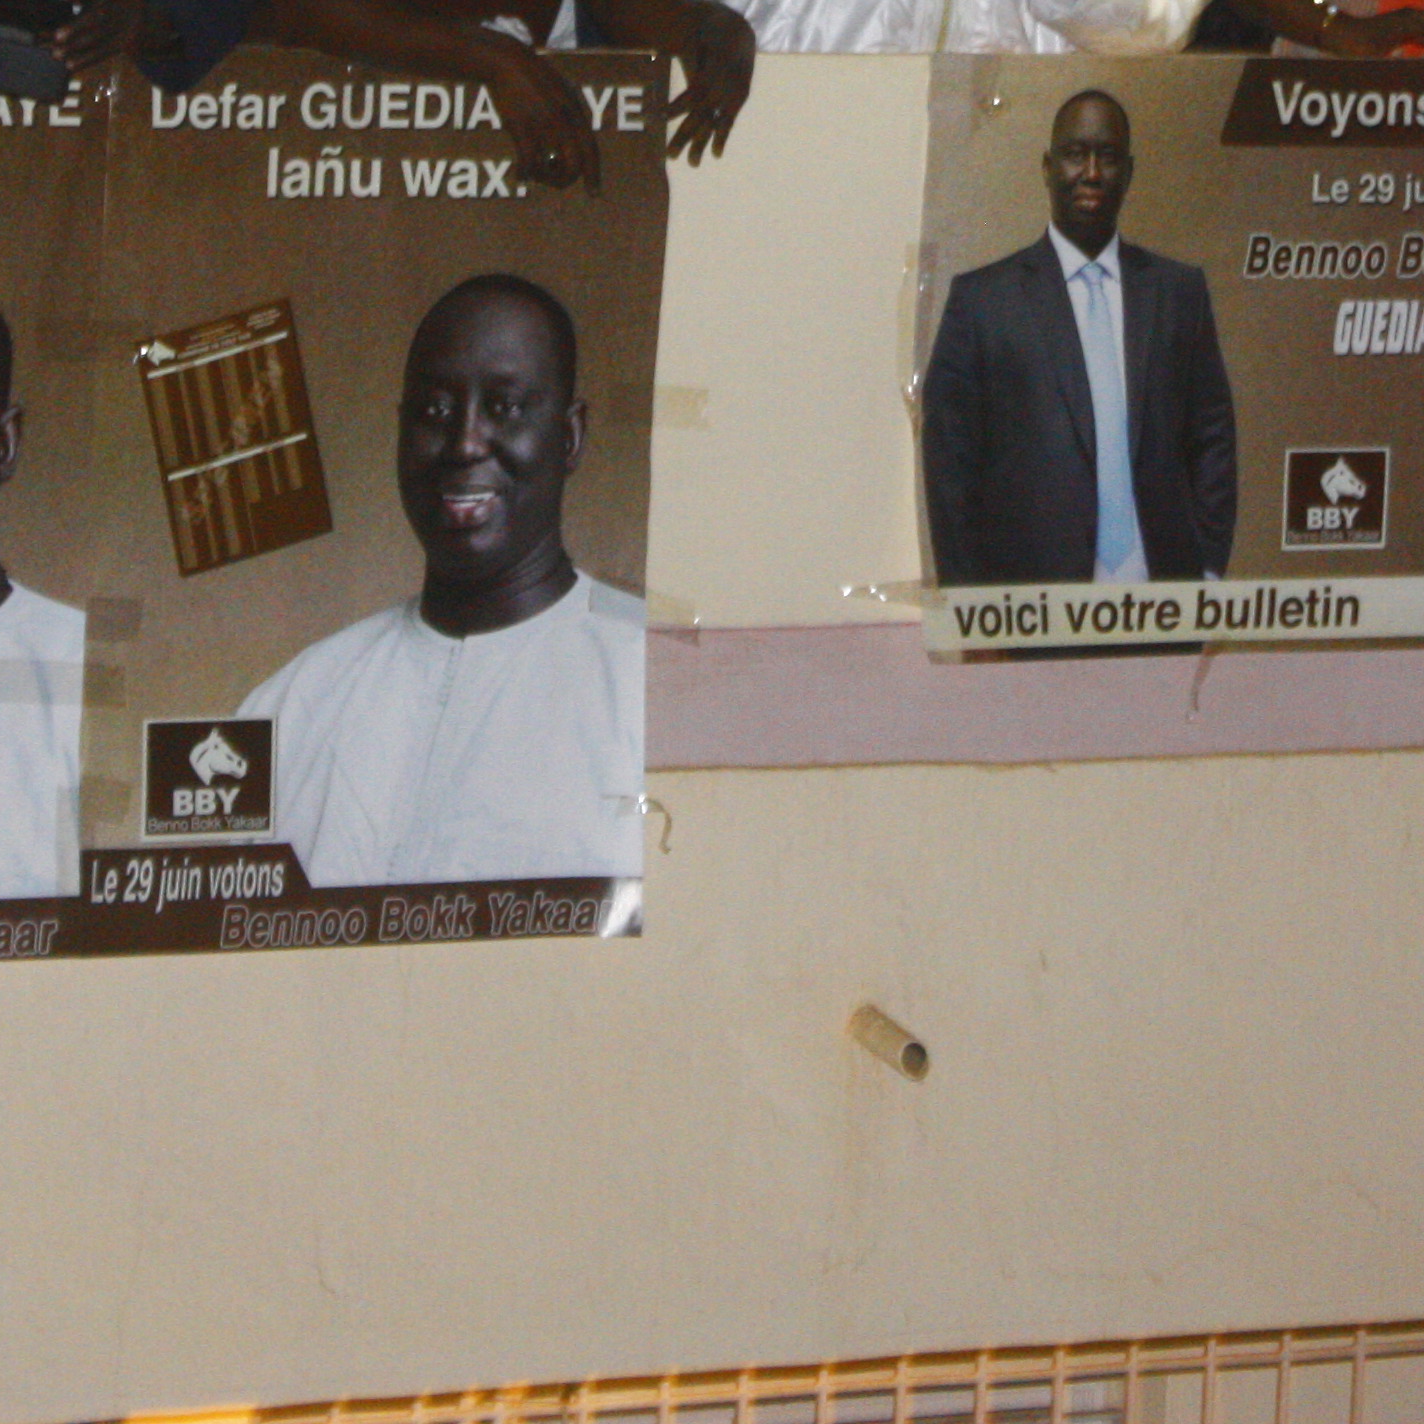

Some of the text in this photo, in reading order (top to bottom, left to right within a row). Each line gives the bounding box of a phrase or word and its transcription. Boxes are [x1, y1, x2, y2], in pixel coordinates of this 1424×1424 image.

[151, 82, 644, 132] Defar GUEDIAYE
[402, 157, 527, 198] wax
[1311, 173, 1349, 204] Le
[1359, 173, 1394, 204] 29
[1244, 231, 1387, 279] Bennoo
[1307, 507, 1359, 530] BBY
[954, 586, 1361, 639] voici votre bulletin
[173, 786, 240, 816] BBY
[91, 858, 284, 914] Le 29 juin votons
[219, 903, 366, 950] Bennoo
[379, 895, 476, 942] Bokk
